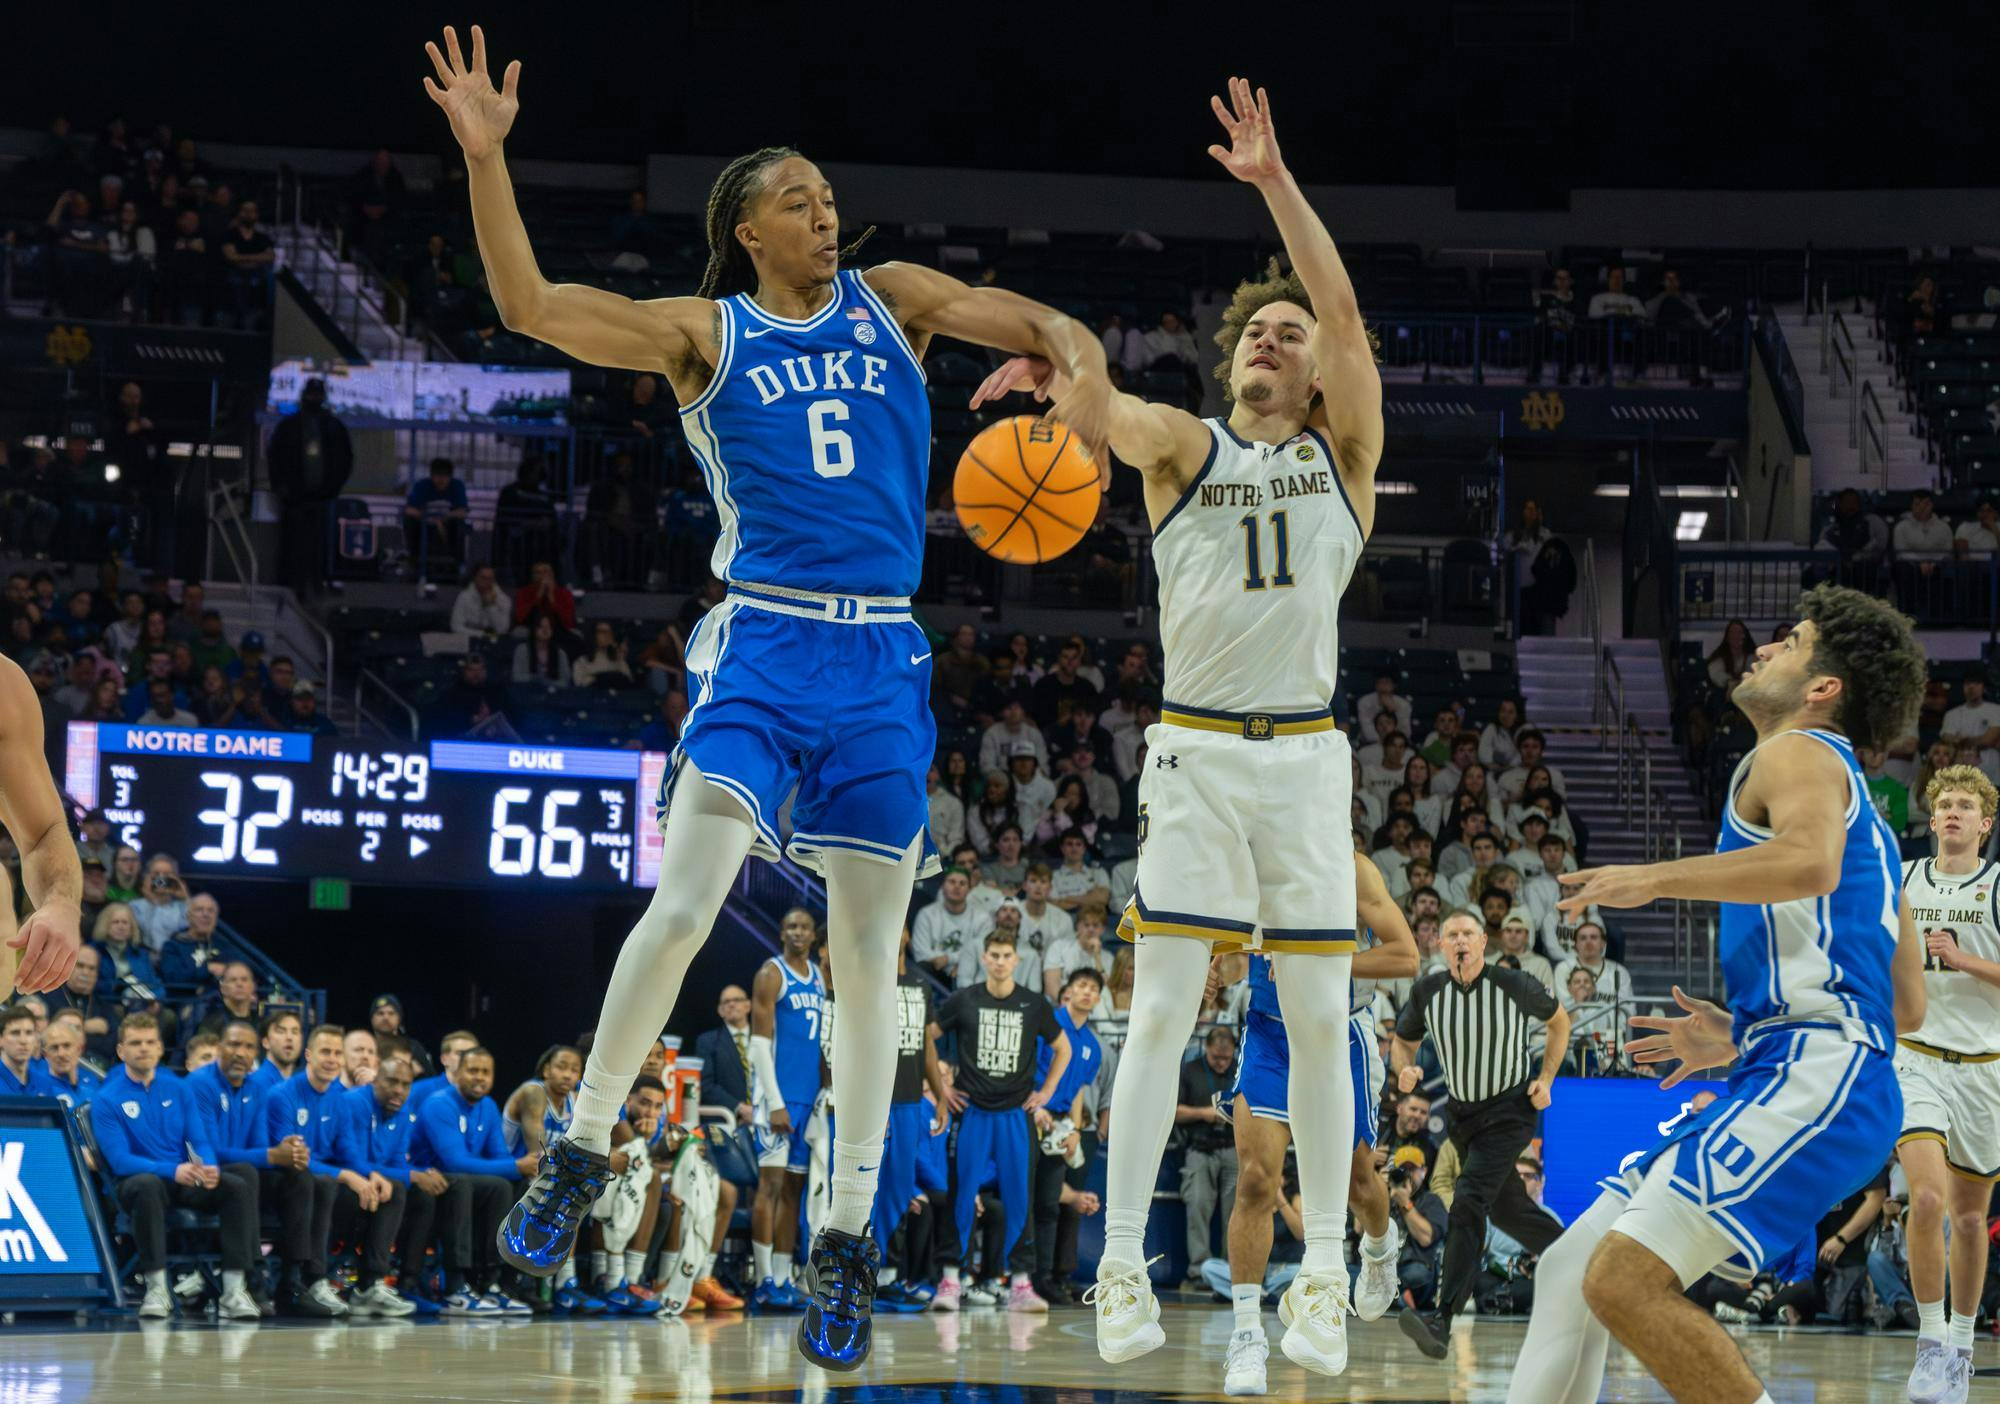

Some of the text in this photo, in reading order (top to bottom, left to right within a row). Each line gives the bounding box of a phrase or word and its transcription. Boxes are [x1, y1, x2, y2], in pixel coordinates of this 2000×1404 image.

[746, 350, 887, 405] DUKE
[807, 398, 855, 478] 6
[1200, 471, 1331, 507] NOTRE DAME
[1239, 508, 1296, 592] 11
[127, 730, 283, 757] NOTRE DAME
[508, 750, 564, 770] DUKE
[332, 752, 429, 801] 14:29
[114, 780, 131, 807] 3
[599, 790, 625, 804] TOL
[193, 771, 293, 865] 32
[302, 808, 343, 826] POSS
[356, 811, 388, 828] PER
[401, 814, 443, 831] POSS
[606, 804, 622, 830] 3
[489, 787, 585, 878] 66
[591, 832, 631, 847] FOULS
[360, 832, 380, 861] 2
[610, 850, 630, 882] 4
[1910, 908, 1983, 925] OTRE DAME
[806, 1010, 818, 1040] 7
[979, 1008, 1024, 1029] THIS GAME
[898, 1029, 924, 1051] ECRET
[978, 1025, 1023, 1053] IS NO
[977, 1048, 1020, 1073] SECRET
[1709, 1131, 1756, 1178] D
